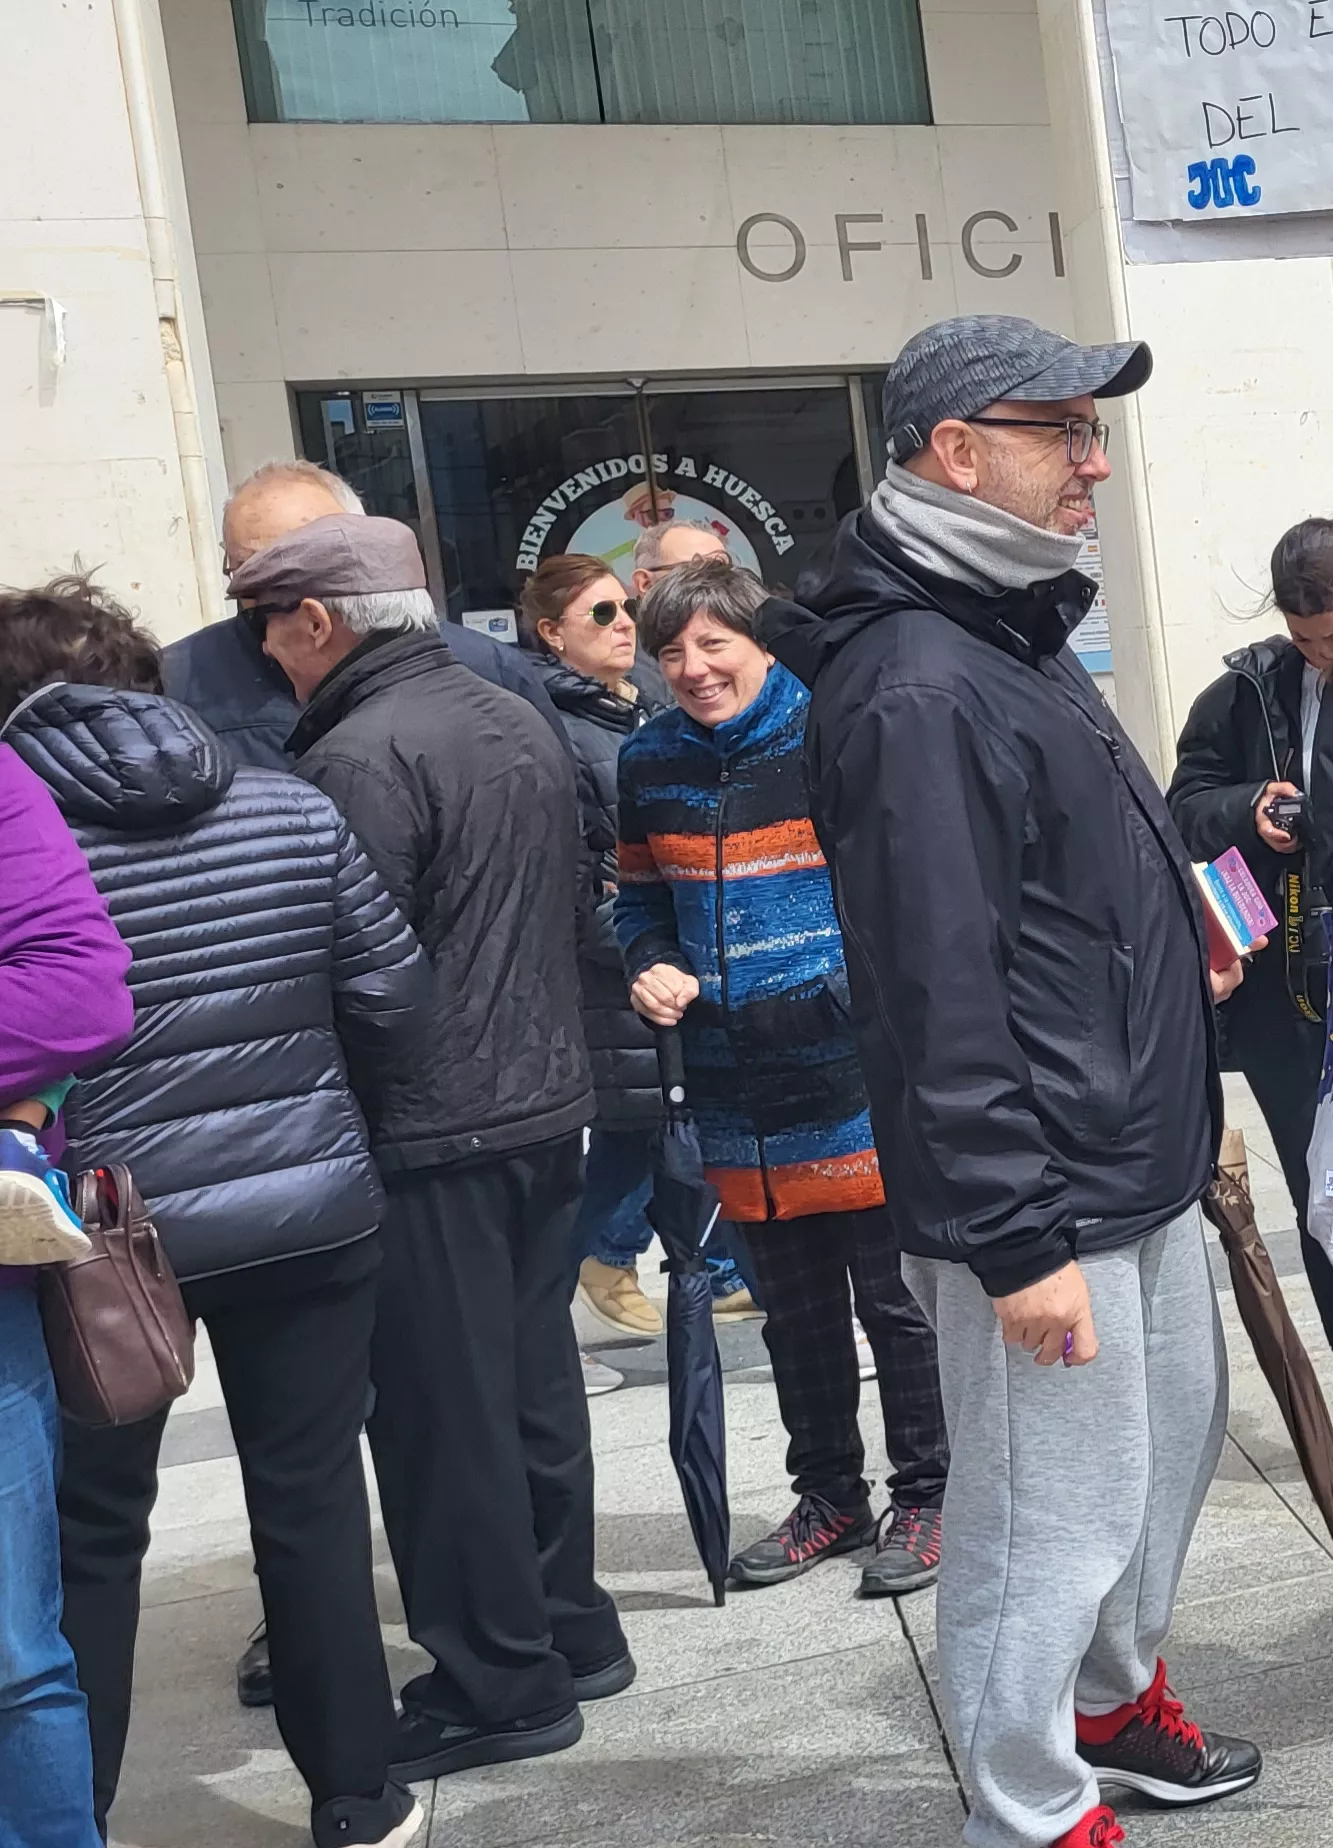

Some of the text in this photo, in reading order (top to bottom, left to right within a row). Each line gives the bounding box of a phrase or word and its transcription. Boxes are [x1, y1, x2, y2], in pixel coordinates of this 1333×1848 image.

[297, 0, 459, 28] Tradición
[1164, 11, 1277, 57] TODO
[1201, 93, 1300, 149] DEL
[515, 453, 796, 573] BIENVENIDOS A HUESCA
[1288, 874, 1300, 913] Nikon
